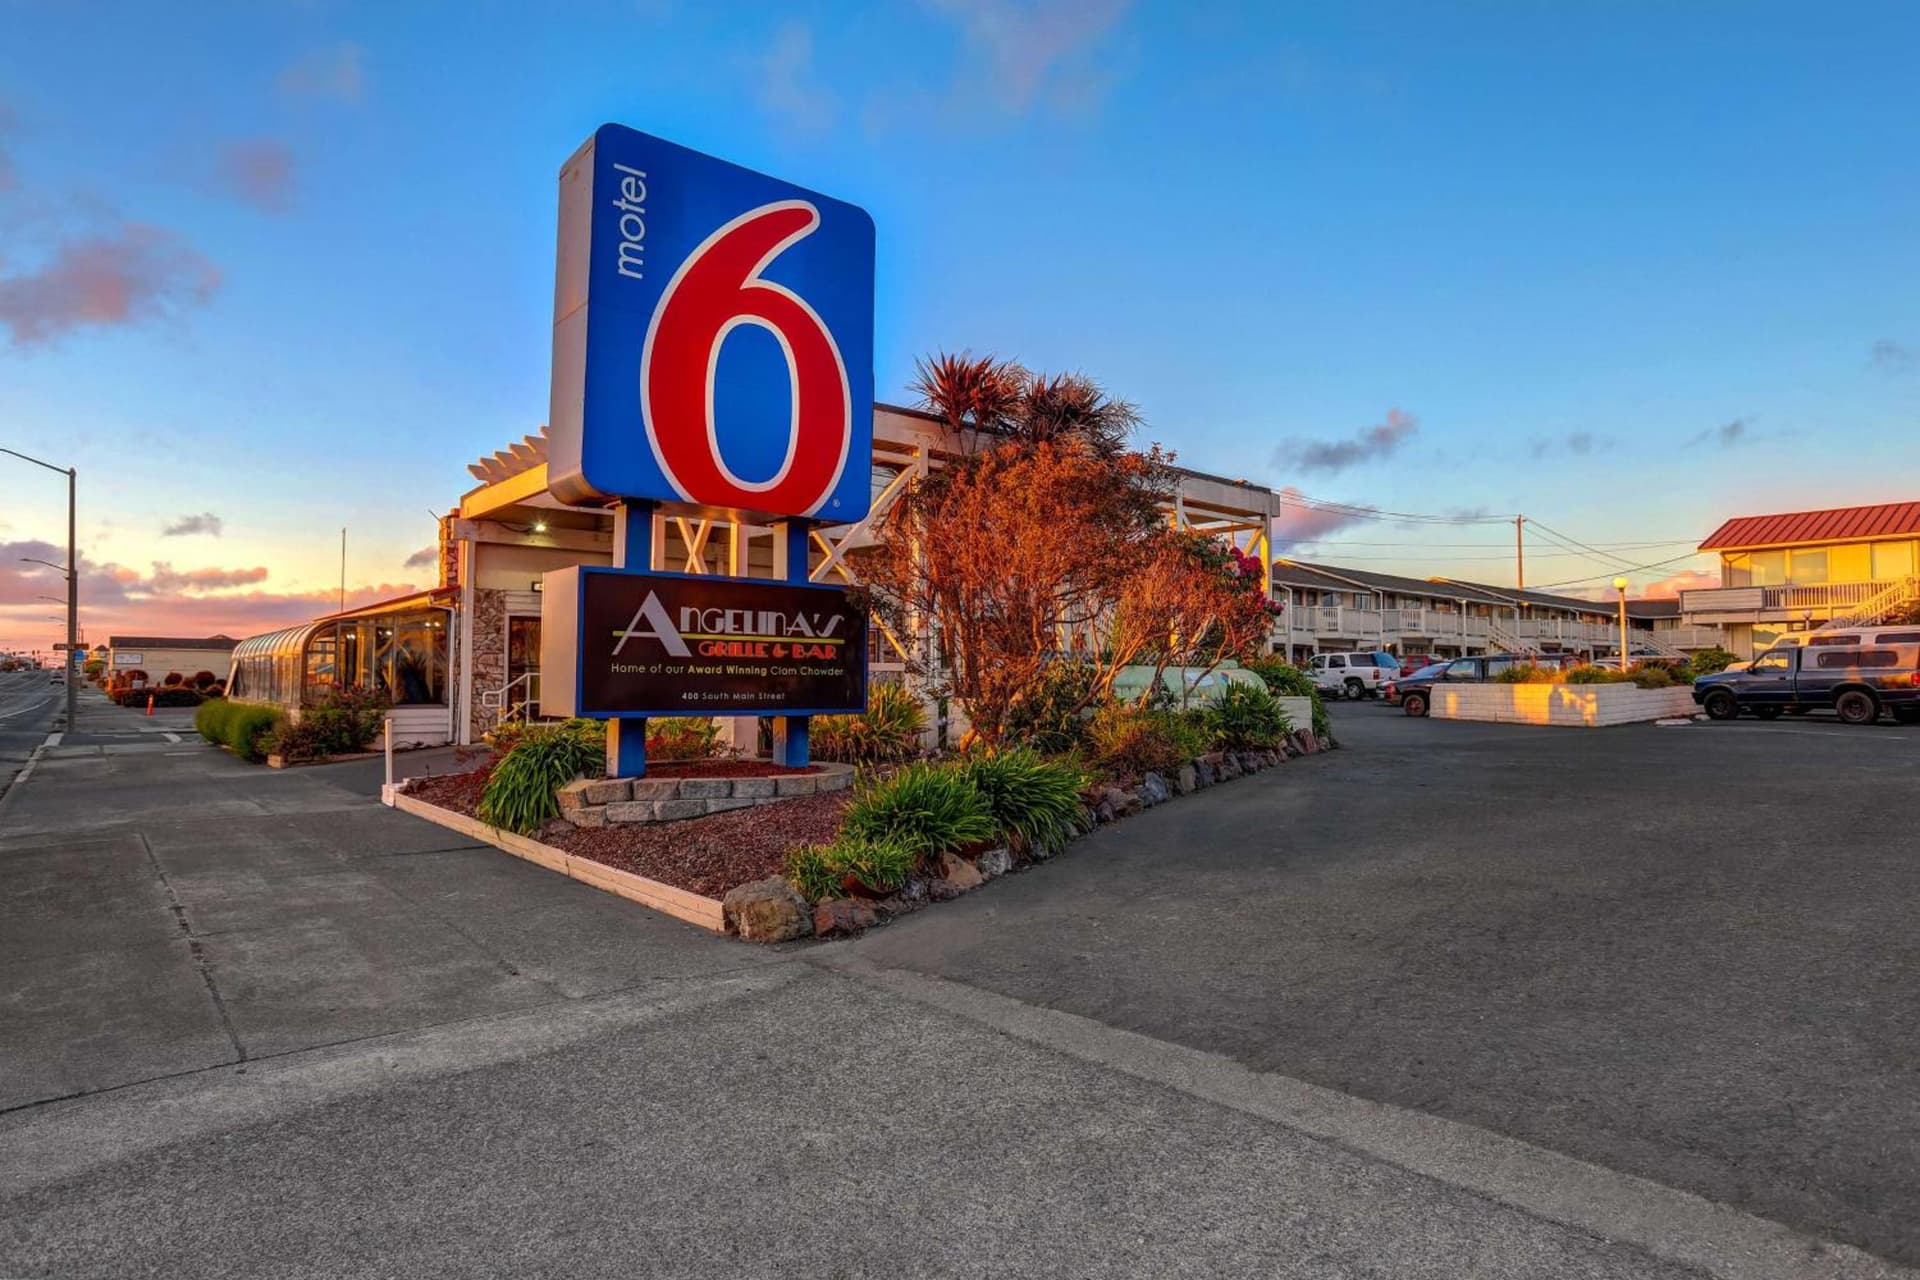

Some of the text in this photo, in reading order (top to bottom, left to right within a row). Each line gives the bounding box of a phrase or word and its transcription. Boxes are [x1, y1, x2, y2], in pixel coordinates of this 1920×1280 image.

[613, 163, 647, 279] motel
[640, 200, 852, 517] 6
[698, 640, 837, 660] GRILLE & BAR
[611, 663, 844, 677] Home of our Award Winning Clam Chowder
[681, 692, 699, 700] 400
[702, 692, 729, 700] South
